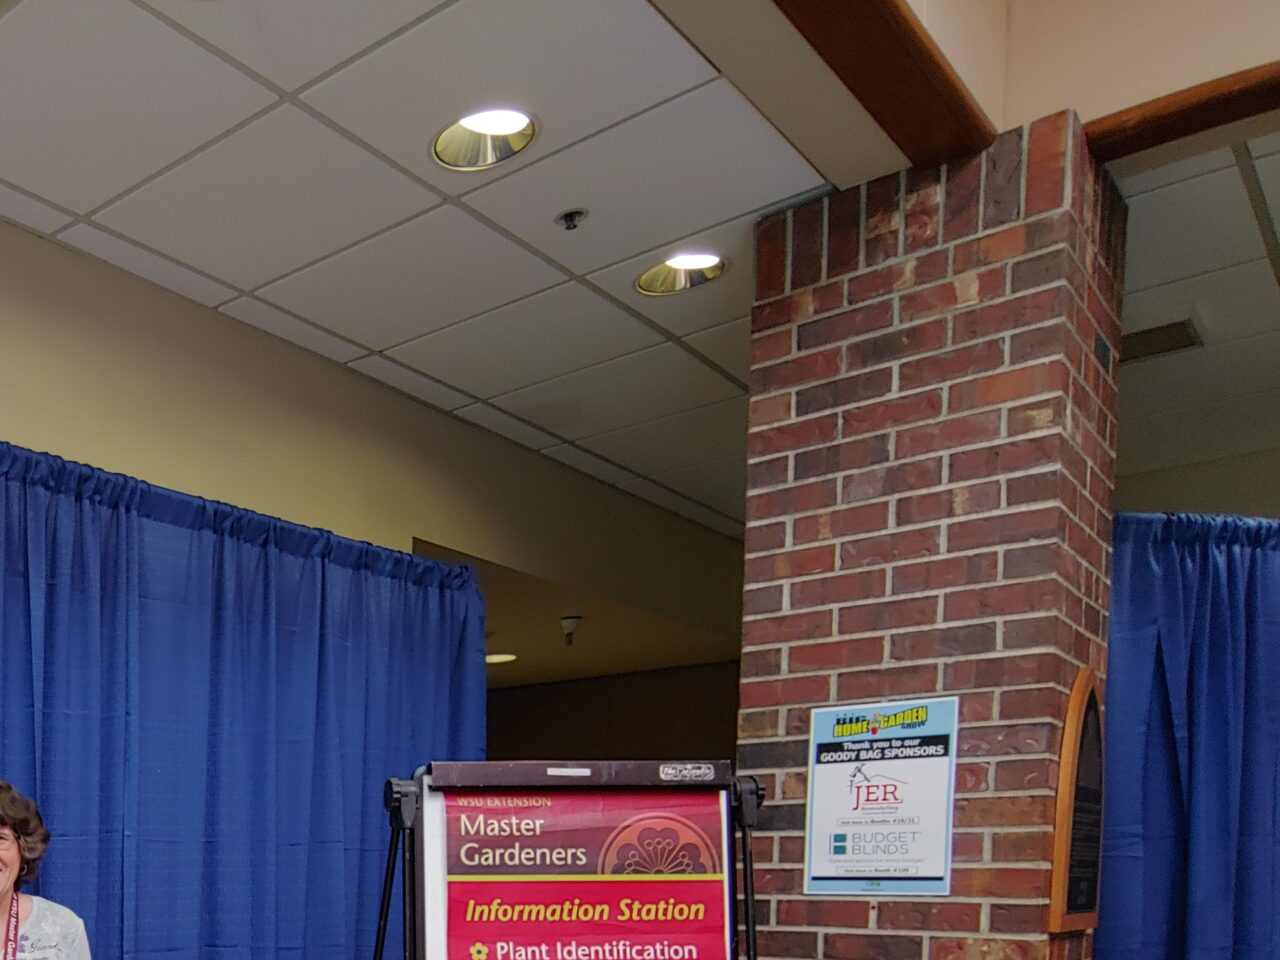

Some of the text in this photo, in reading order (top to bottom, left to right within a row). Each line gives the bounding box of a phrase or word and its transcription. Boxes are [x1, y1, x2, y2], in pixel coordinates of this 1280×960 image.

[833, 705, 928, 738] HOME GARDEN
[820, 745, 945, 762] GOODY BAG SPONSORS
[843, 738, 922, 750] Thank you to our
[457, 796, 552, 807] WSU EXTENSION
[852, 783, 900, 811] JER
[459, 814, 545, 837] Master
[851, 831, 919, 844] BUDGET
[459, 842, 588, 866] Gardeners
[851, 843, 910, 855] BLINDS
[465, 898, 706, 922] Information Station
